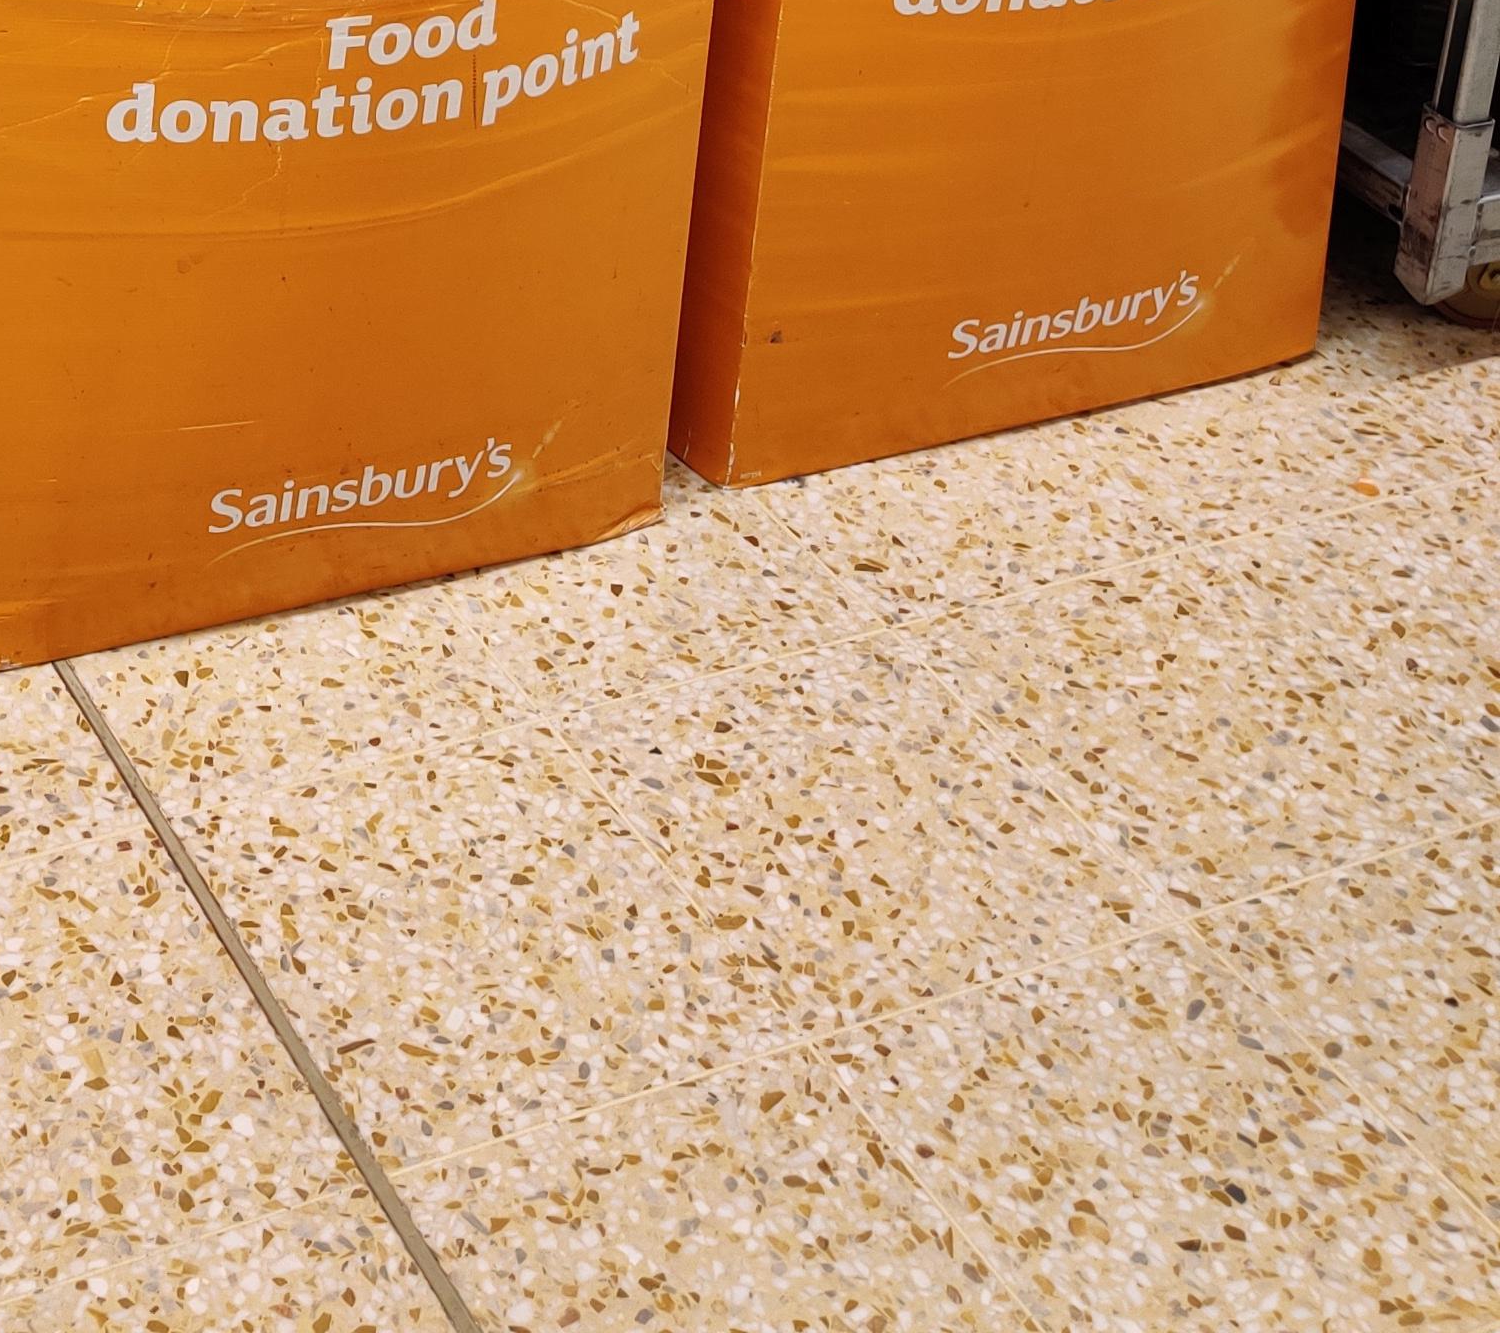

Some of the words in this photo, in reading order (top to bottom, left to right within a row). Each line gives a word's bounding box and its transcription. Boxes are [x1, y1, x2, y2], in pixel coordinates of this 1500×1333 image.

[106, 77, 464, 144] donation
[480, 10, 642, 127] point
[947, 268, 1200, 360] Sainsbury's
[208, 435, 513, 536] Sainsbury's
